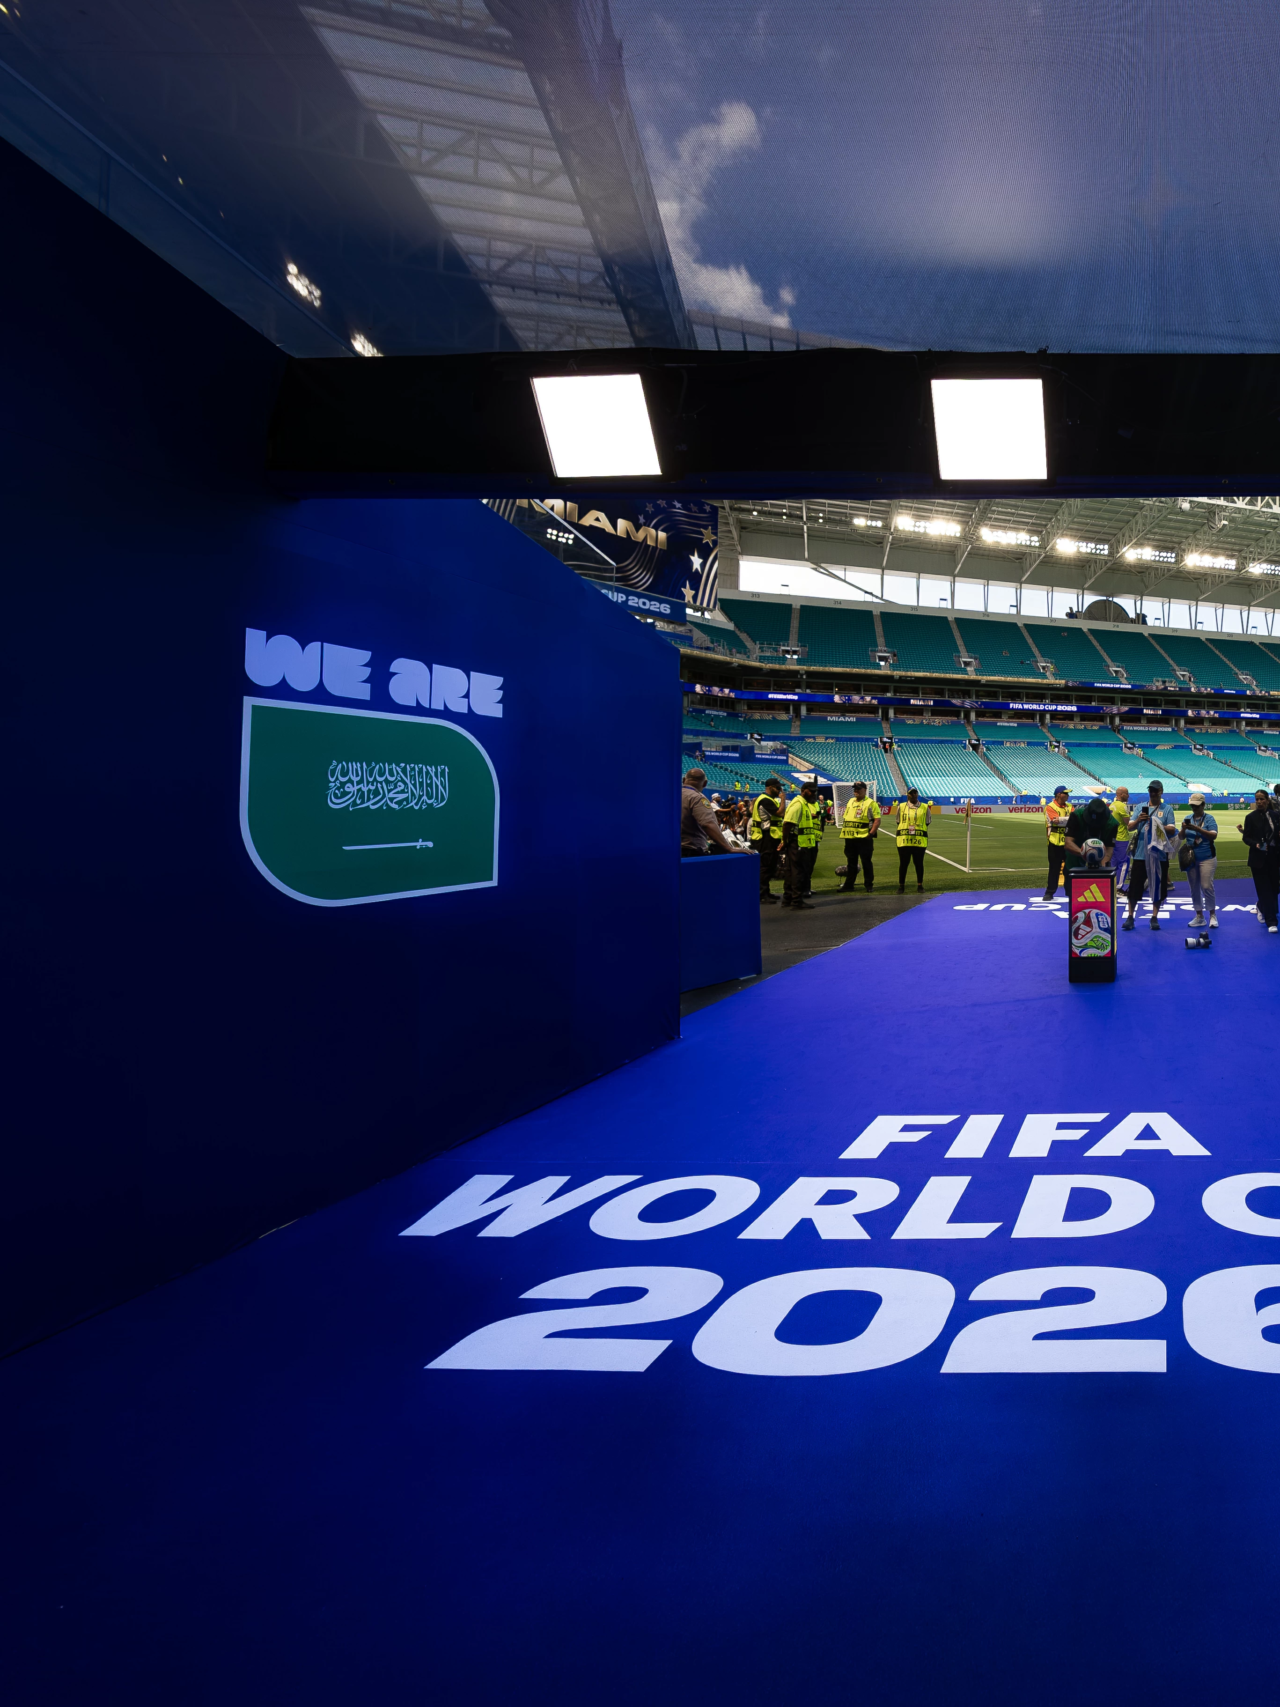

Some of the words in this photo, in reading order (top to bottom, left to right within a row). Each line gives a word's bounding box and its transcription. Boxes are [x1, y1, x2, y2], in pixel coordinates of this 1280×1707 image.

[516, 499, 667, 550] MIAMI
[628, 595, 671, 614] 2026
[244, 627, 372, 700] WE
[954, 805, 992, 814] veizon
[1008, 804, 1044, 813] verizon
[952, 903, 1062, 911] CUP
[838, 1112, 1212, 1159] FIFA
[399, 1174, 1156, 1240] WORLD
